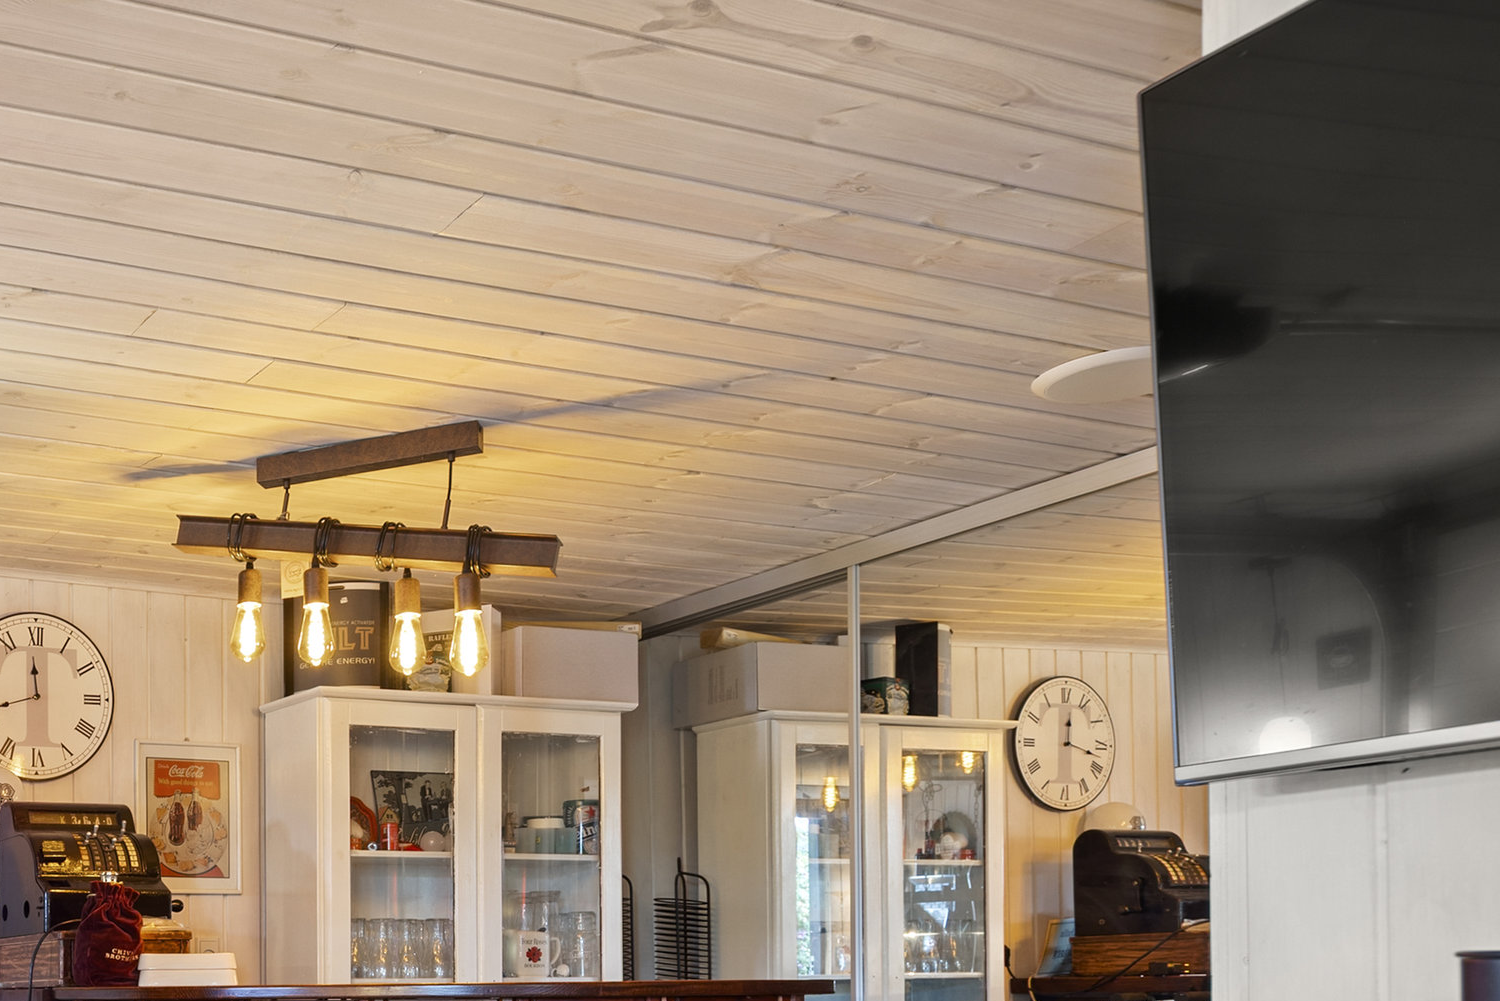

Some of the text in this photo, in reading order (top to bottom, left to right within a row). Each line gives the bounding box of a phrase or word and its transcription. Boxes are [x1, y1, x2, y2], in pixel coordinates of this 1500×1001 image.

[28, 626, 44, 647] XII
[77, 661, 95, 676] II
[84, 694, 101, 705] III
[74, 718, 95, 739] IIII
[0, 737, 17, 760] VII
[31, 748, 45, 767] VI
